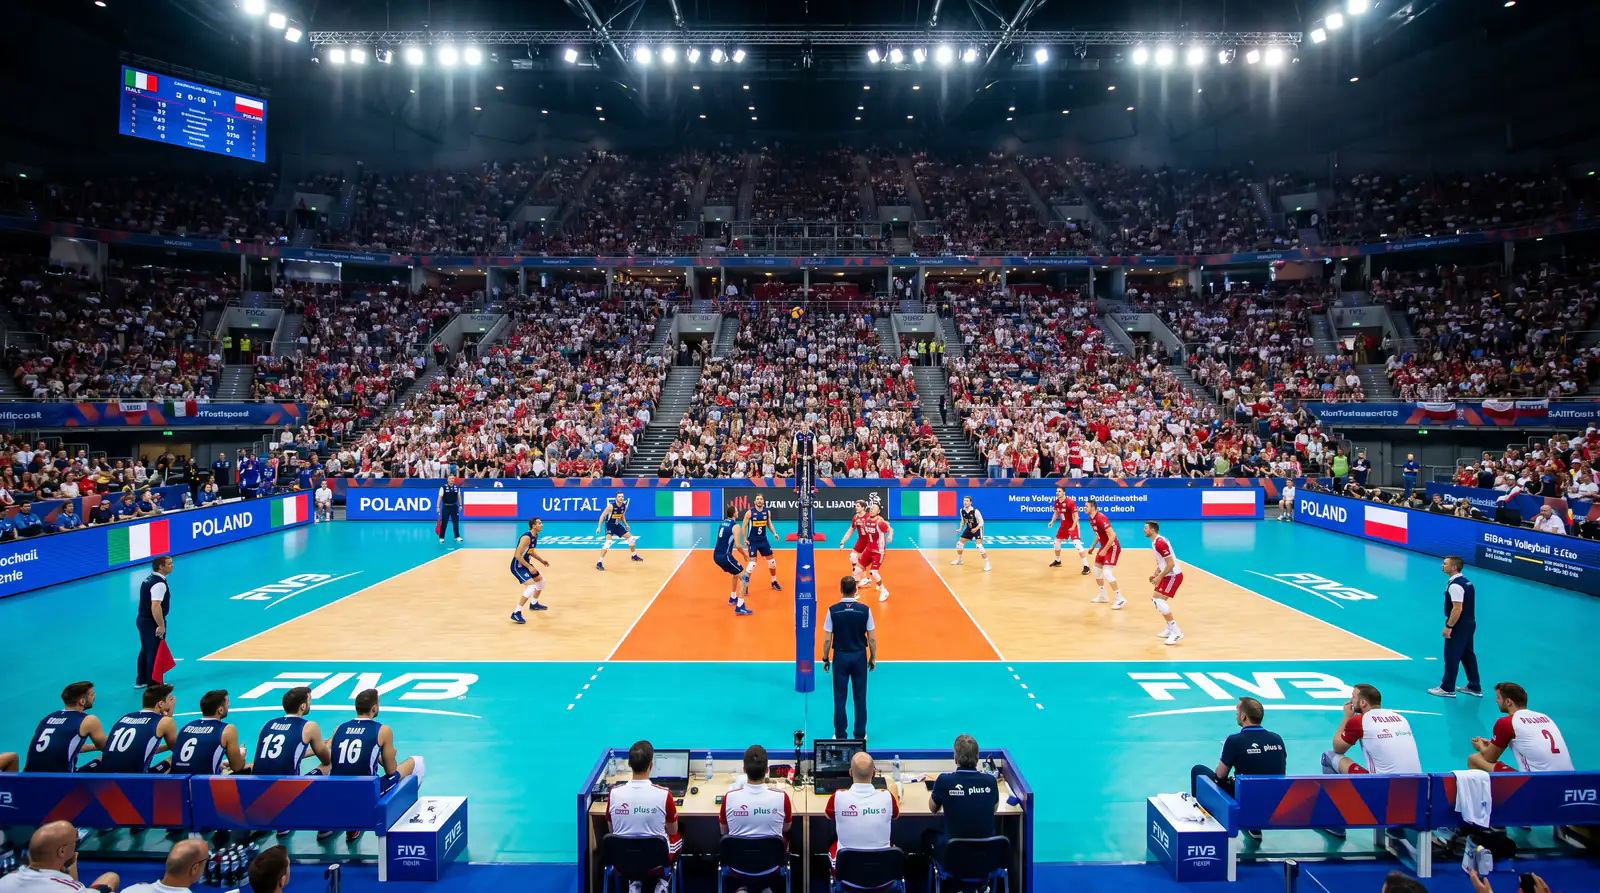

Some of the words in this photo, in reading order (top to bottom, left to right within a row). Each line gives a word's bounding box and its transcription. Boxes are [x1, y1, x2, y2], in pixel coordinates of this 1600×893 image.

[360, 497, 432, 512] POLAND
[1301, 499, 1348, 524] POLAND
[192, 511, 253, 539] POLAND
[238, 672, 479, 700] FIVB
[1127, 672, 1354, 700] FIVB
[36, 728, 56, 753] 5
[108, 727, 137, 753] 10
[179, 737, 198, 762] 6
[260, 734, 286, 759] 13
[1541, 729, 1560, 754] 2
[968, 786, 985, 795] plus
[1564, 788, 1598, 802] FIVB
[633, 806, 651, 815] plus
[753, 807, 771, 816] plus
[862, 807, 881, 816] plus
[444, 820, 462, 851] FIVB
[1152, 820, 1170, 849] FIVB
[397, 845, 427, 856] FIVB
[1187, 845, 1217, 856] FIVB
